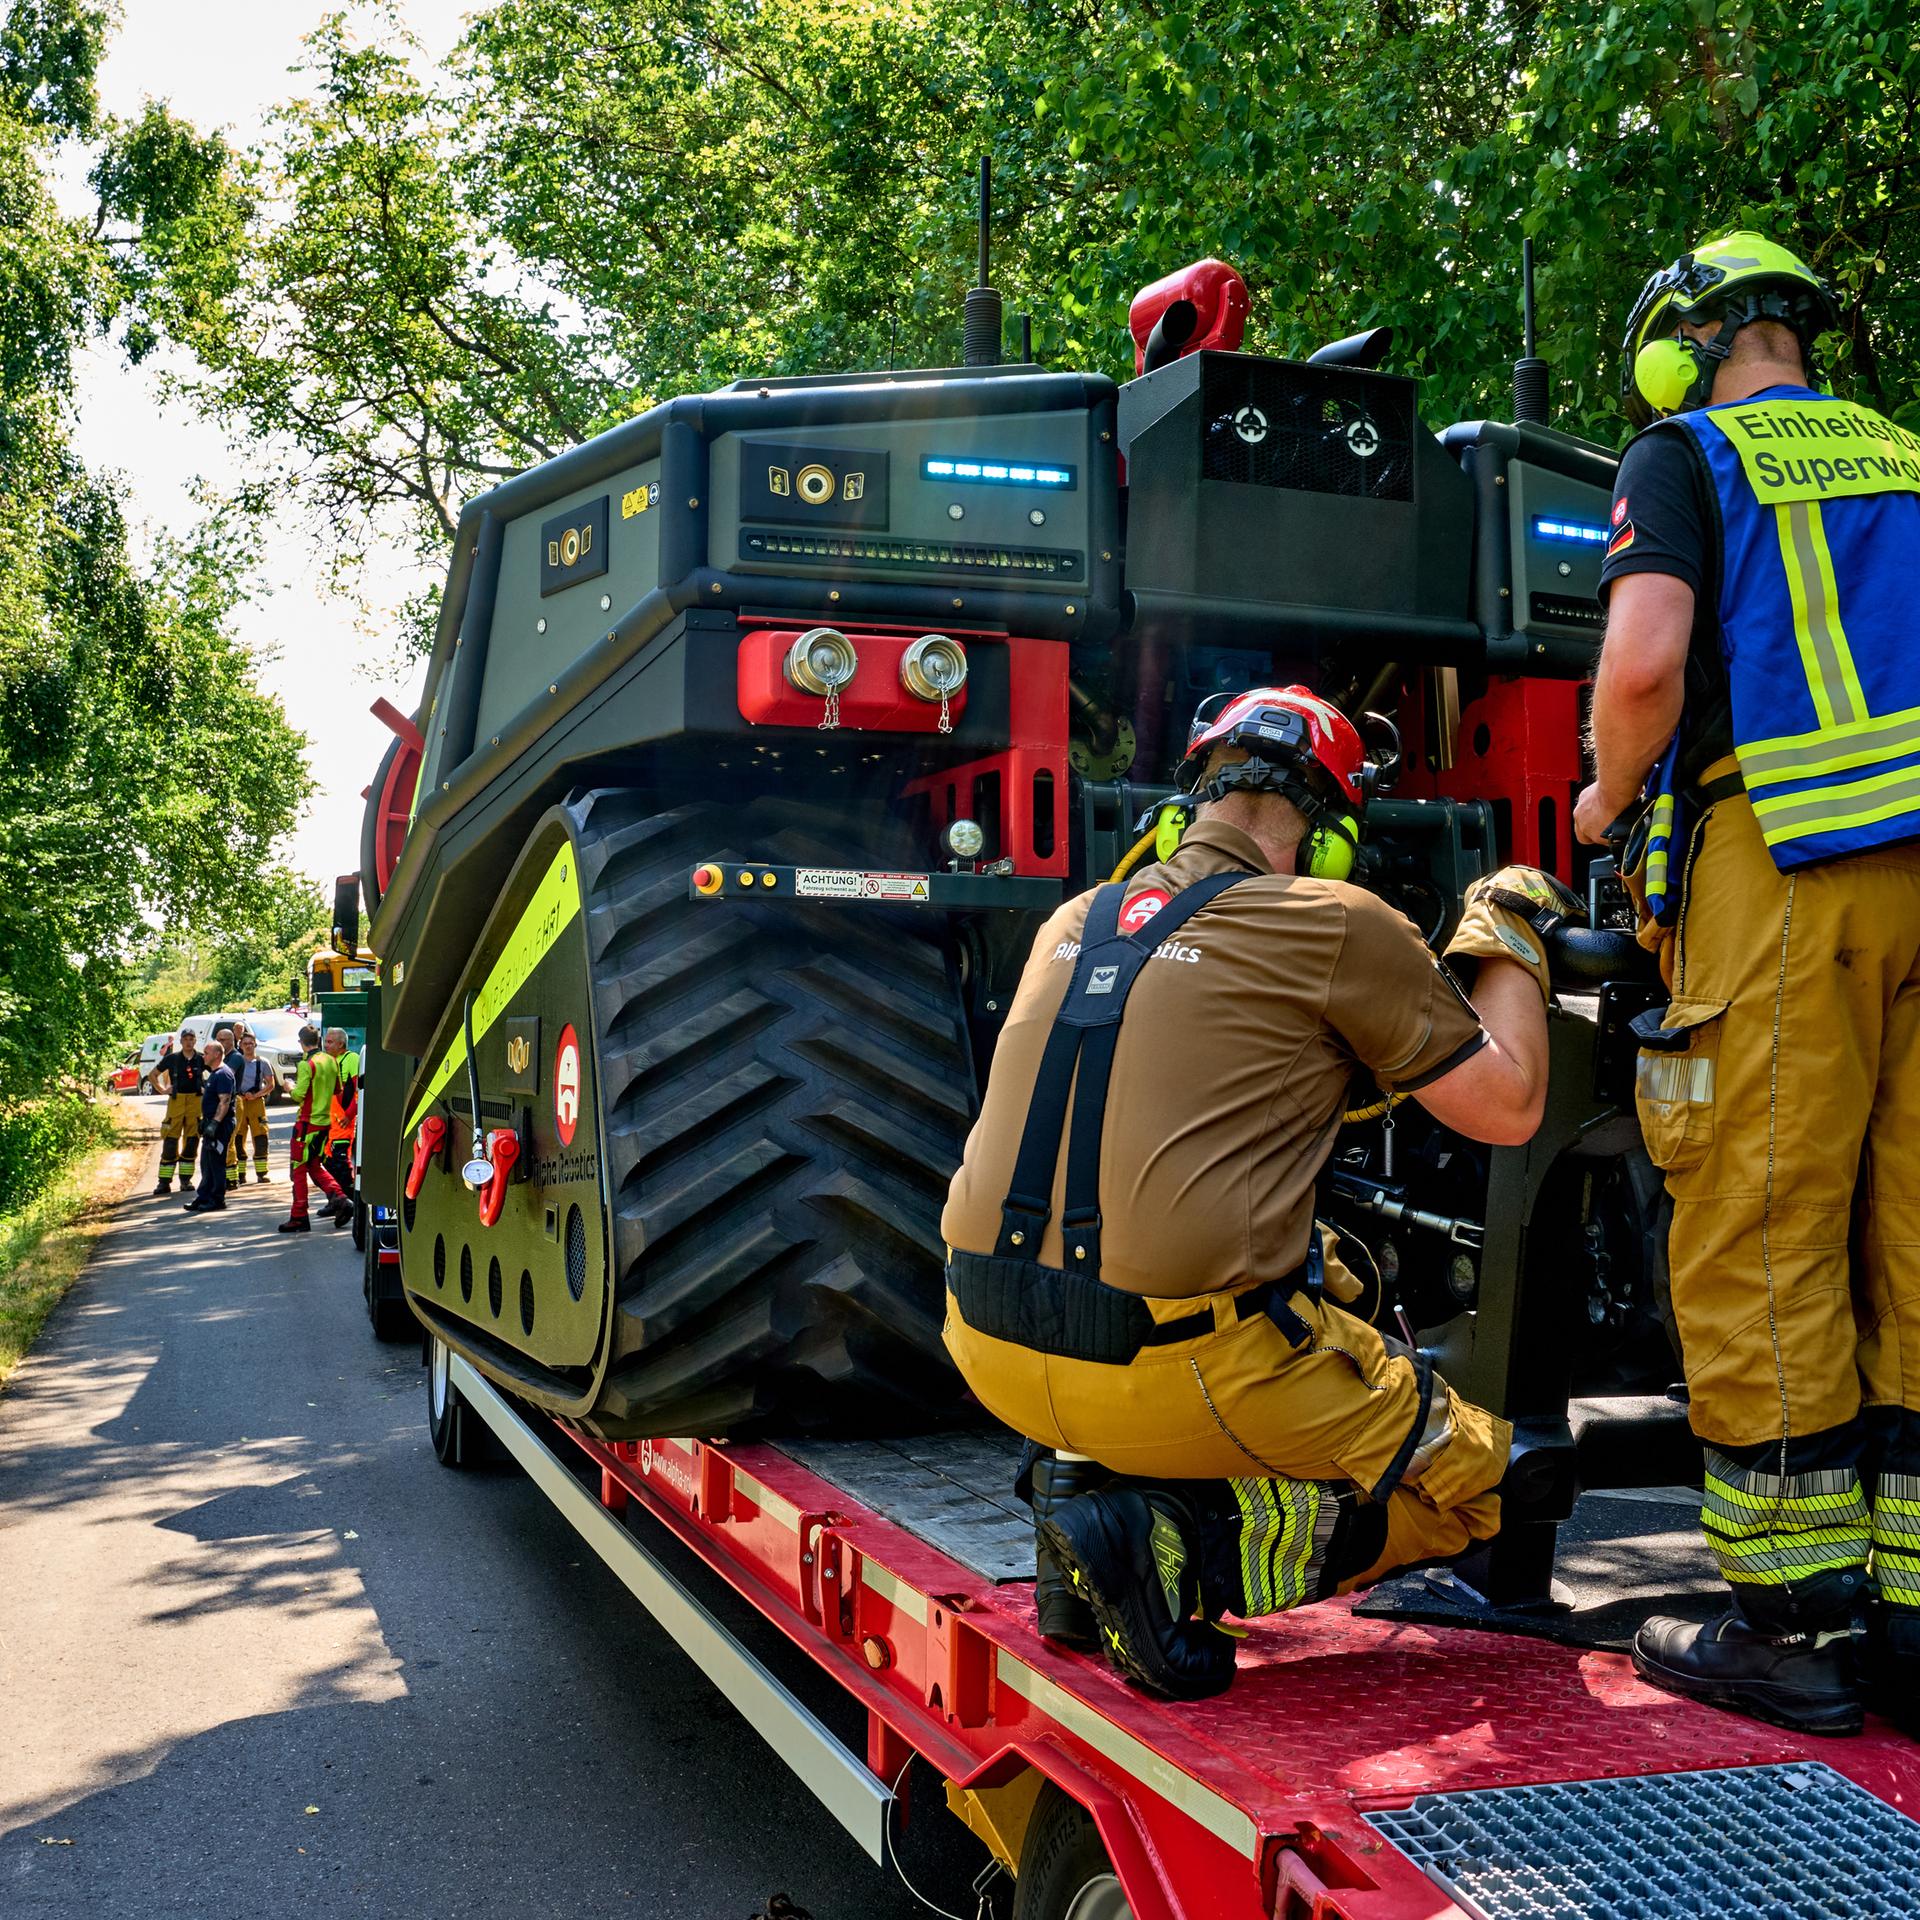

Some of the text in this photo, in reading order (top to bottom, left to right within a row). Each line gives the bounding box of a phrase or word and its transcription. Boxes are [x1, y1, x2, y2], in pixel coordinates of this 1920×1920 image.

[1261, 727, 1281, 737] MSA
[803, 874, 857, 886] ACHTUNG!
[1053, 940, 1082, 961] Alp
[558, 1148, 595, 1185] Robotics
